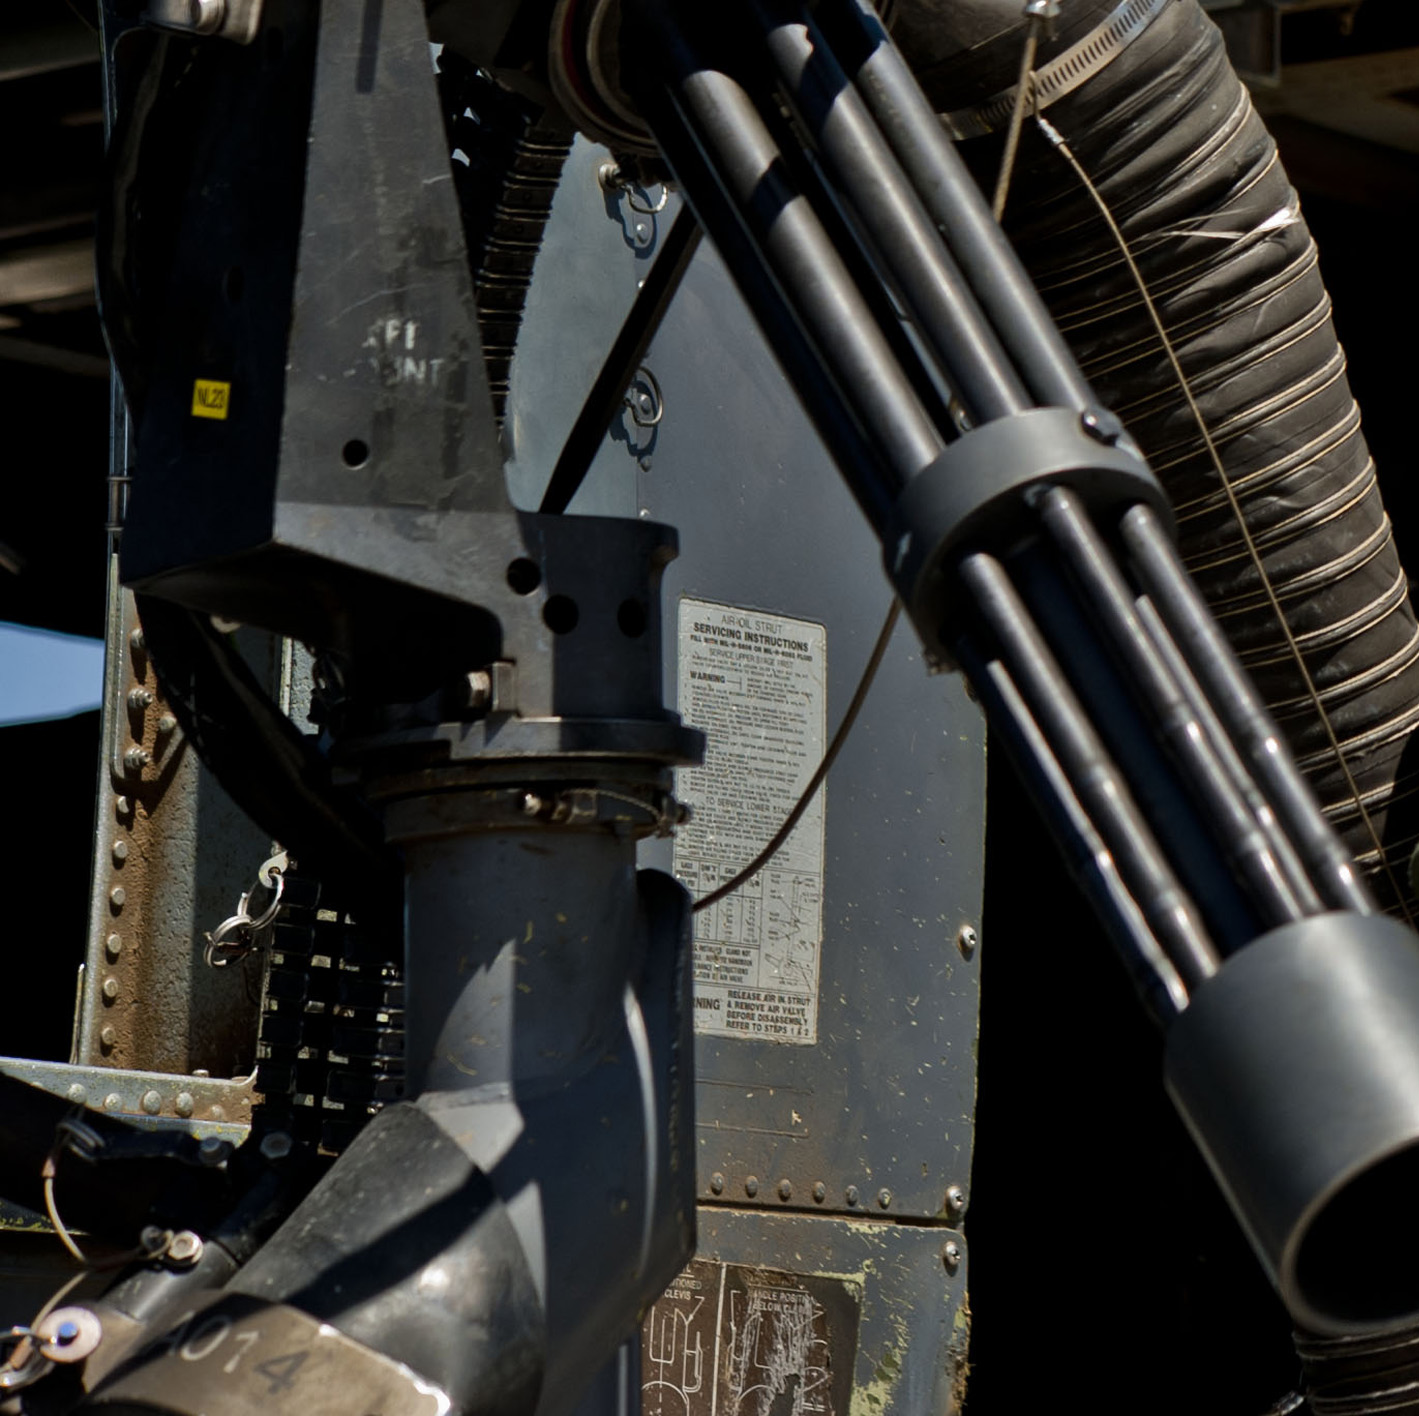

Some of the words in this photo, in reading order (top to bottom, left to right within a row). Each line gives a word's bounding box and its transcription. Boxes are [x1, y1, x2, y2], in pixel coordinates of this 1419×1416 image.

[755, 620, 782, 635] STRUT
[693, 622, 742, 640] SERVICING
[744, 632, 809, 652] INSTRUCTIONS
[690, 671, 725, 683] WARNING
[694, 996, 720, 1010] NING
[728, 990, 761, 1001] RELEASE
[764, 994, 776, 1003] AIR
[778, 995, 785, 1003] IN
[788, 996, 810, 1005] STRUT
[734, 1001, 765, 1012] REMOVE
[768, 1004, 780, 1013] AIR
[782, 1006, 805, 1017] VALVE
[727, 1010, 755, 1021] BEFORE
[758, 1013, 807, 1026] DISASSEMBLY
[726, 1020, 750, 1030] REFER
[752, 1023, 762, 1032] TO
[765, 1025, 787, 1034] STEPS
[664, 1289, 691, 1301] CLEVIS
